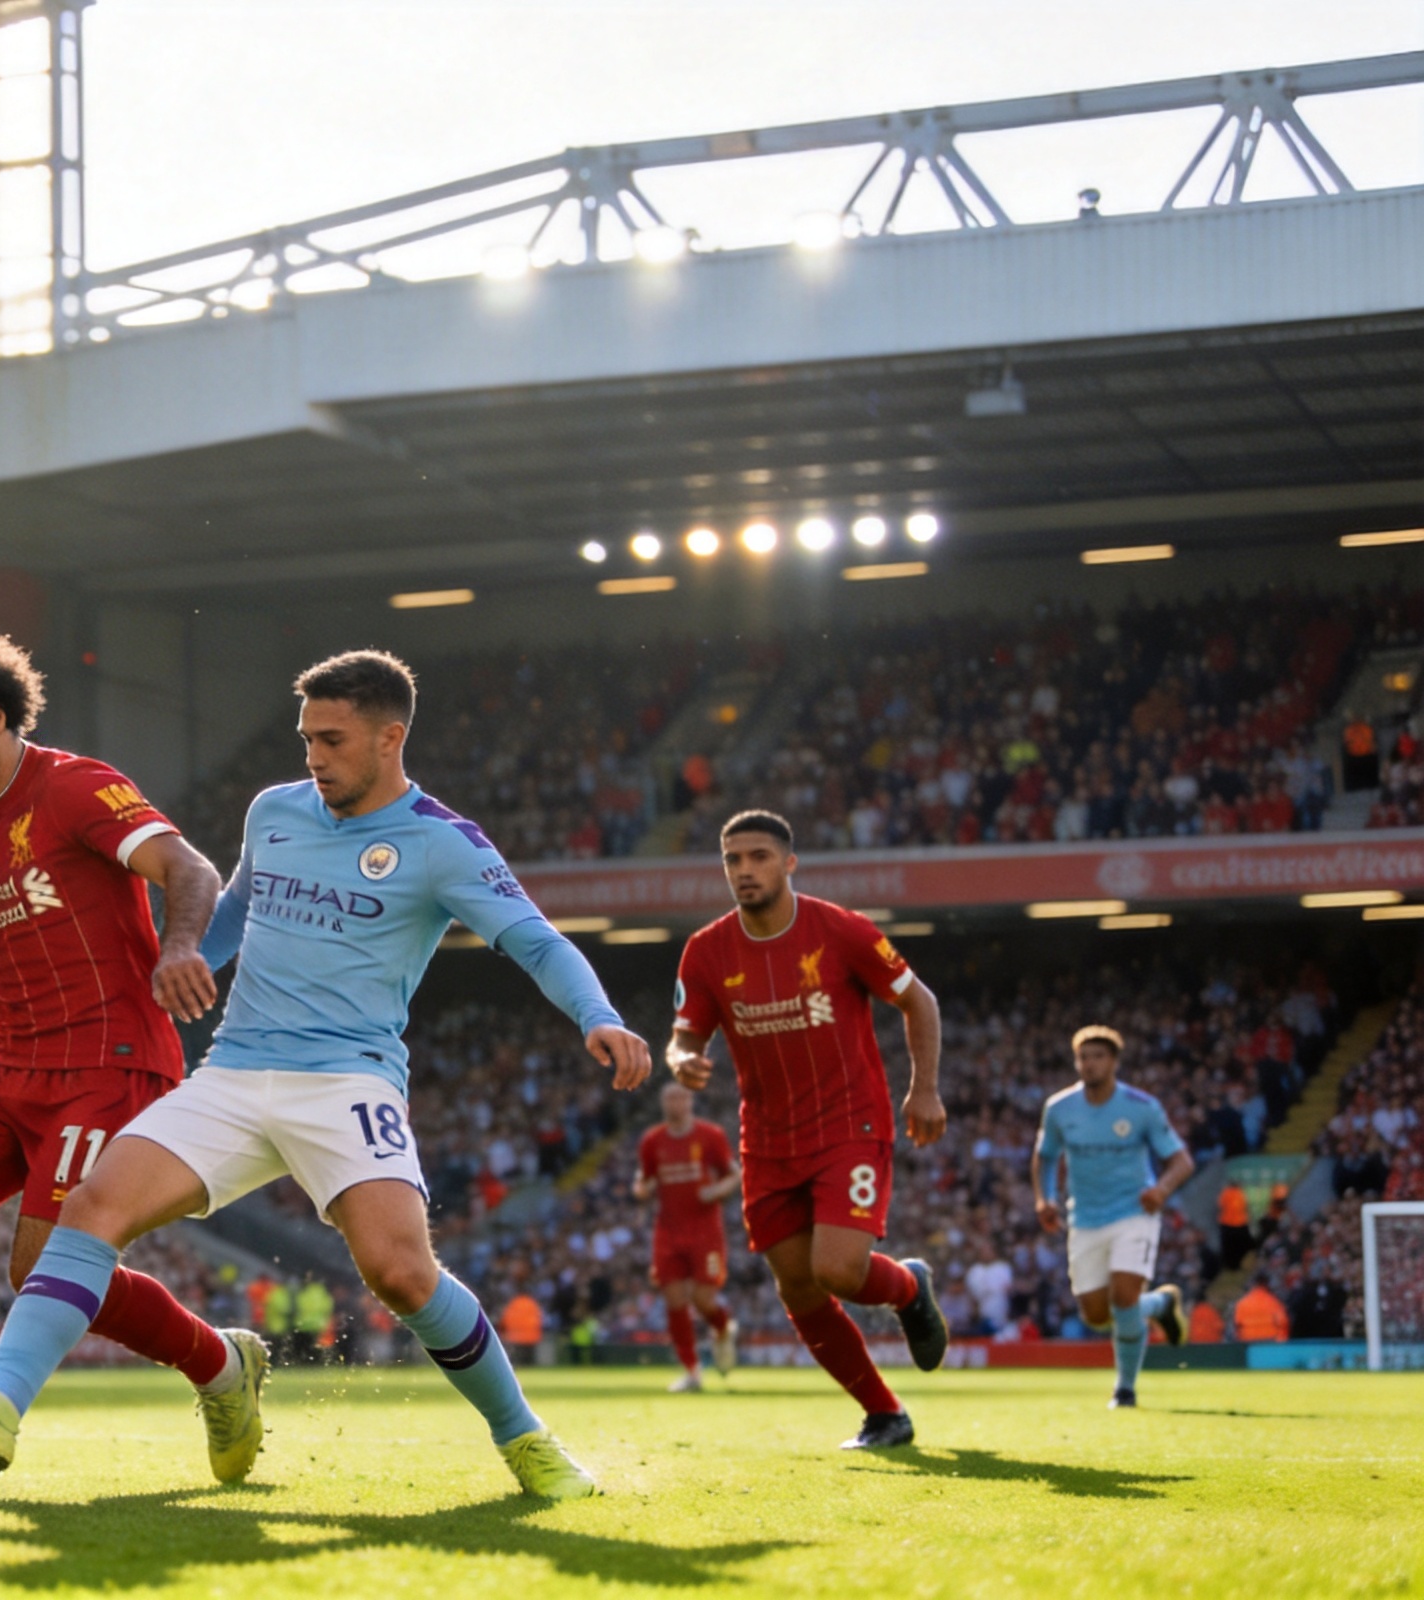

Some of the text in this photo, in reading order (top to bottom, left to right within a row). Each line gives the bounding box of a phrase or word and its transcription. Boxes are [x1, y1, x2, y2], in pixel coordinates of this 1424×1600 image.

[252, 871, 384, 919] ETIHAD
[350, 1102, 408, 1151] 18
[55, 1125, 106, 1183] 11
[848, 1164, 876, 1208] 8
